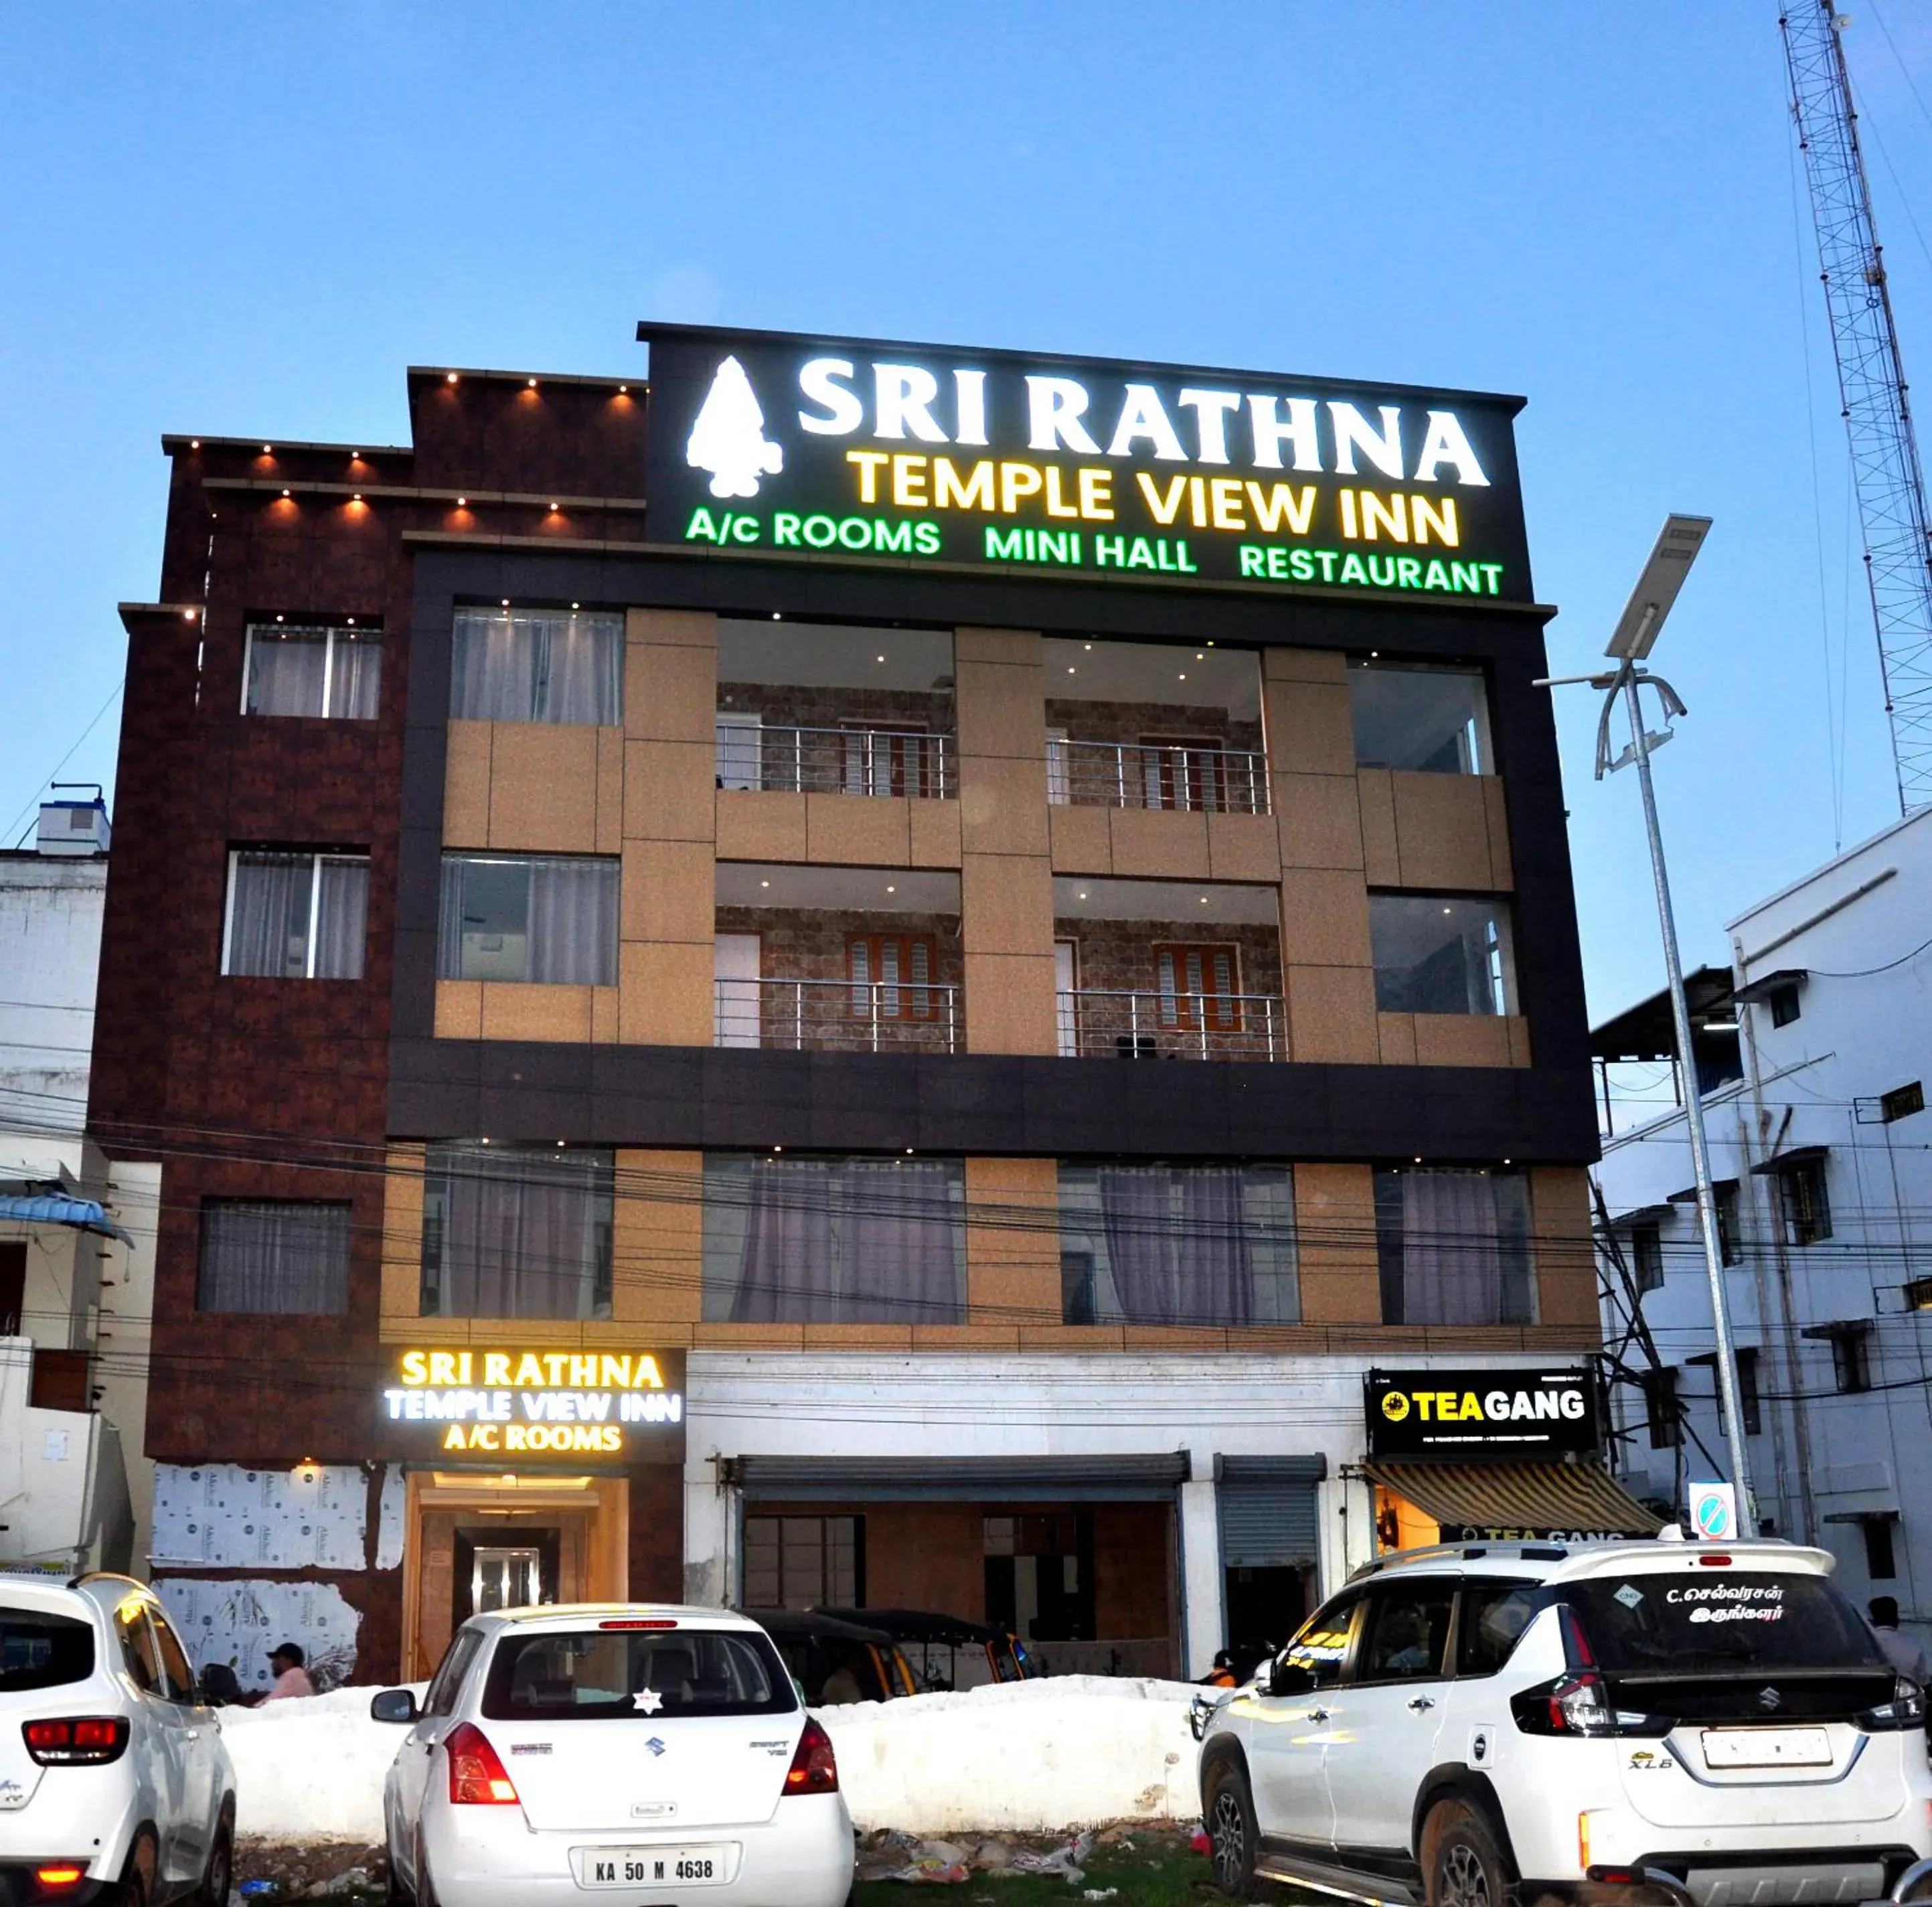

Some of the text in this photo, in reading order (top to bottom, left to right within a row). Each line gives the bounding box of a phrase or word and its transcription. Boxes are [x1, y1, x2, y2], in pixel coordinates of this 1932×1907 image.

[797, 357, 1492, 487] SRI RATHNA
[845, 449, 1461, 548] TEMPLE VIEW INN
[774, 512, 941, 555] ROOMS
[984, 526, 1082, 564] MINI
[1095, 533, 1198, 573] HALL
[1238, 544, 1504, 595] RESTAURANT
[401, 1351, 665, 1389] SRI RATHNA
[384, 1388, 682, 1424] TEMPLE VIEW INN
[443, 1423, 623, 1452] A/C ROOMS
[596, 1860, 713, 1881] KA 50 M 4638
